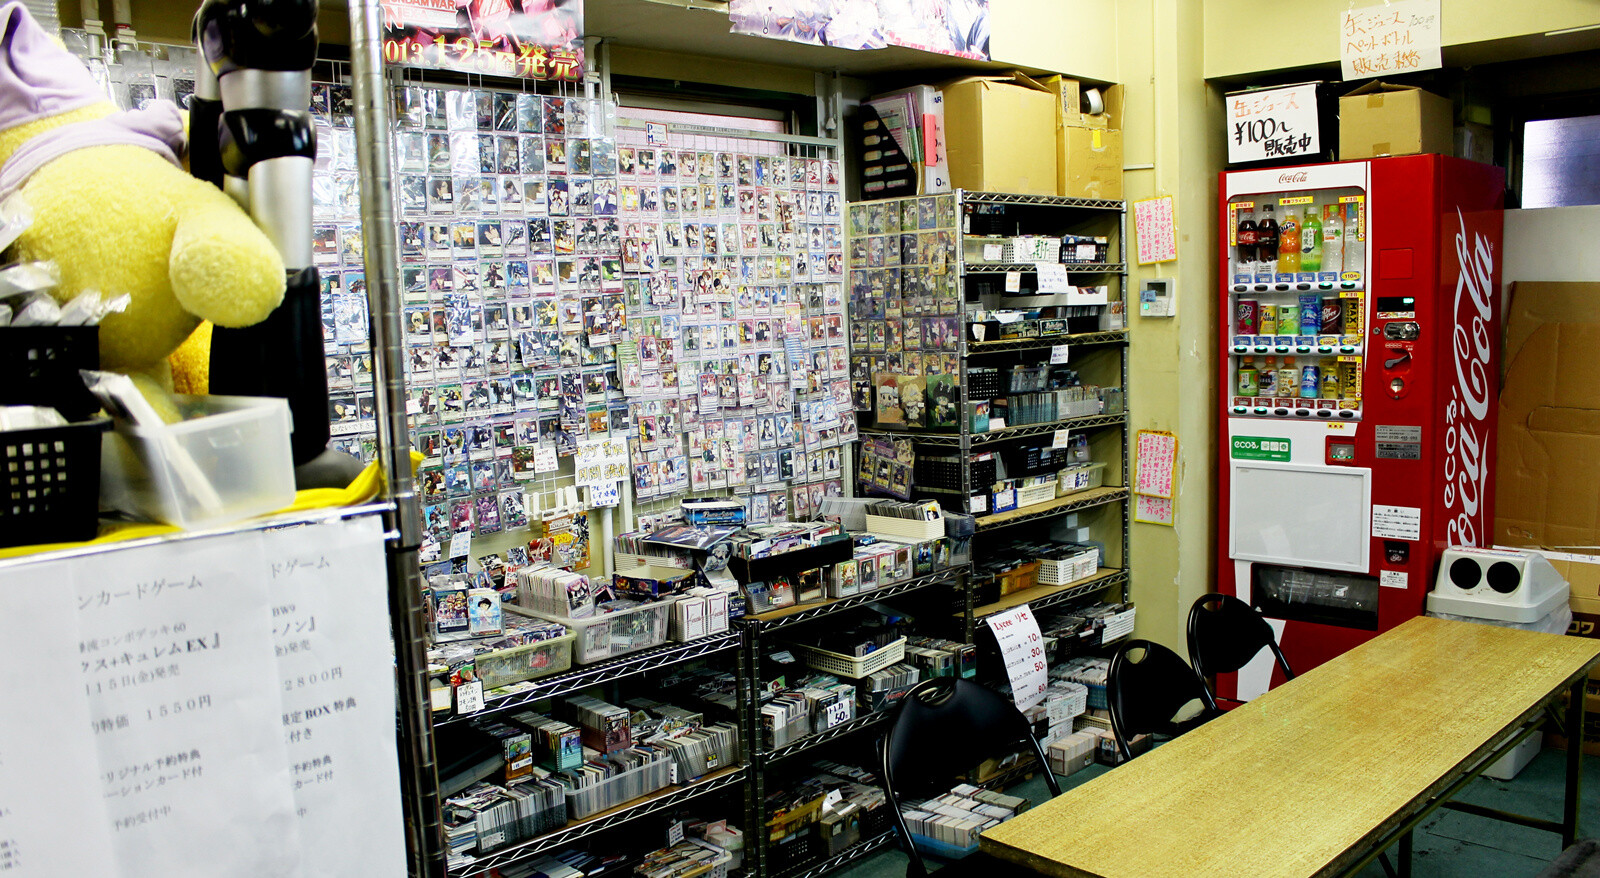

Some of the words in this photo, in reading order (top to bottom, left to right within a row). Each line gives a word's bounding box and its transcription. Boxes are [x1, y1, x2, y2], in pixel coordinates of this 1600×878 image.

[1347, 30, 1413, 54] ペットボトル
[1352, 49, 1421, 75] 販売機
[1264, 132, 1312, 157] 販売中
[1279, 172, 1308, 184] Coca-Cola
[1349, 303, 1357, 323] MAX
[271, 555, 330, 579] ドゲーム
[101, 749, 201, 783] リジナル予約特典
